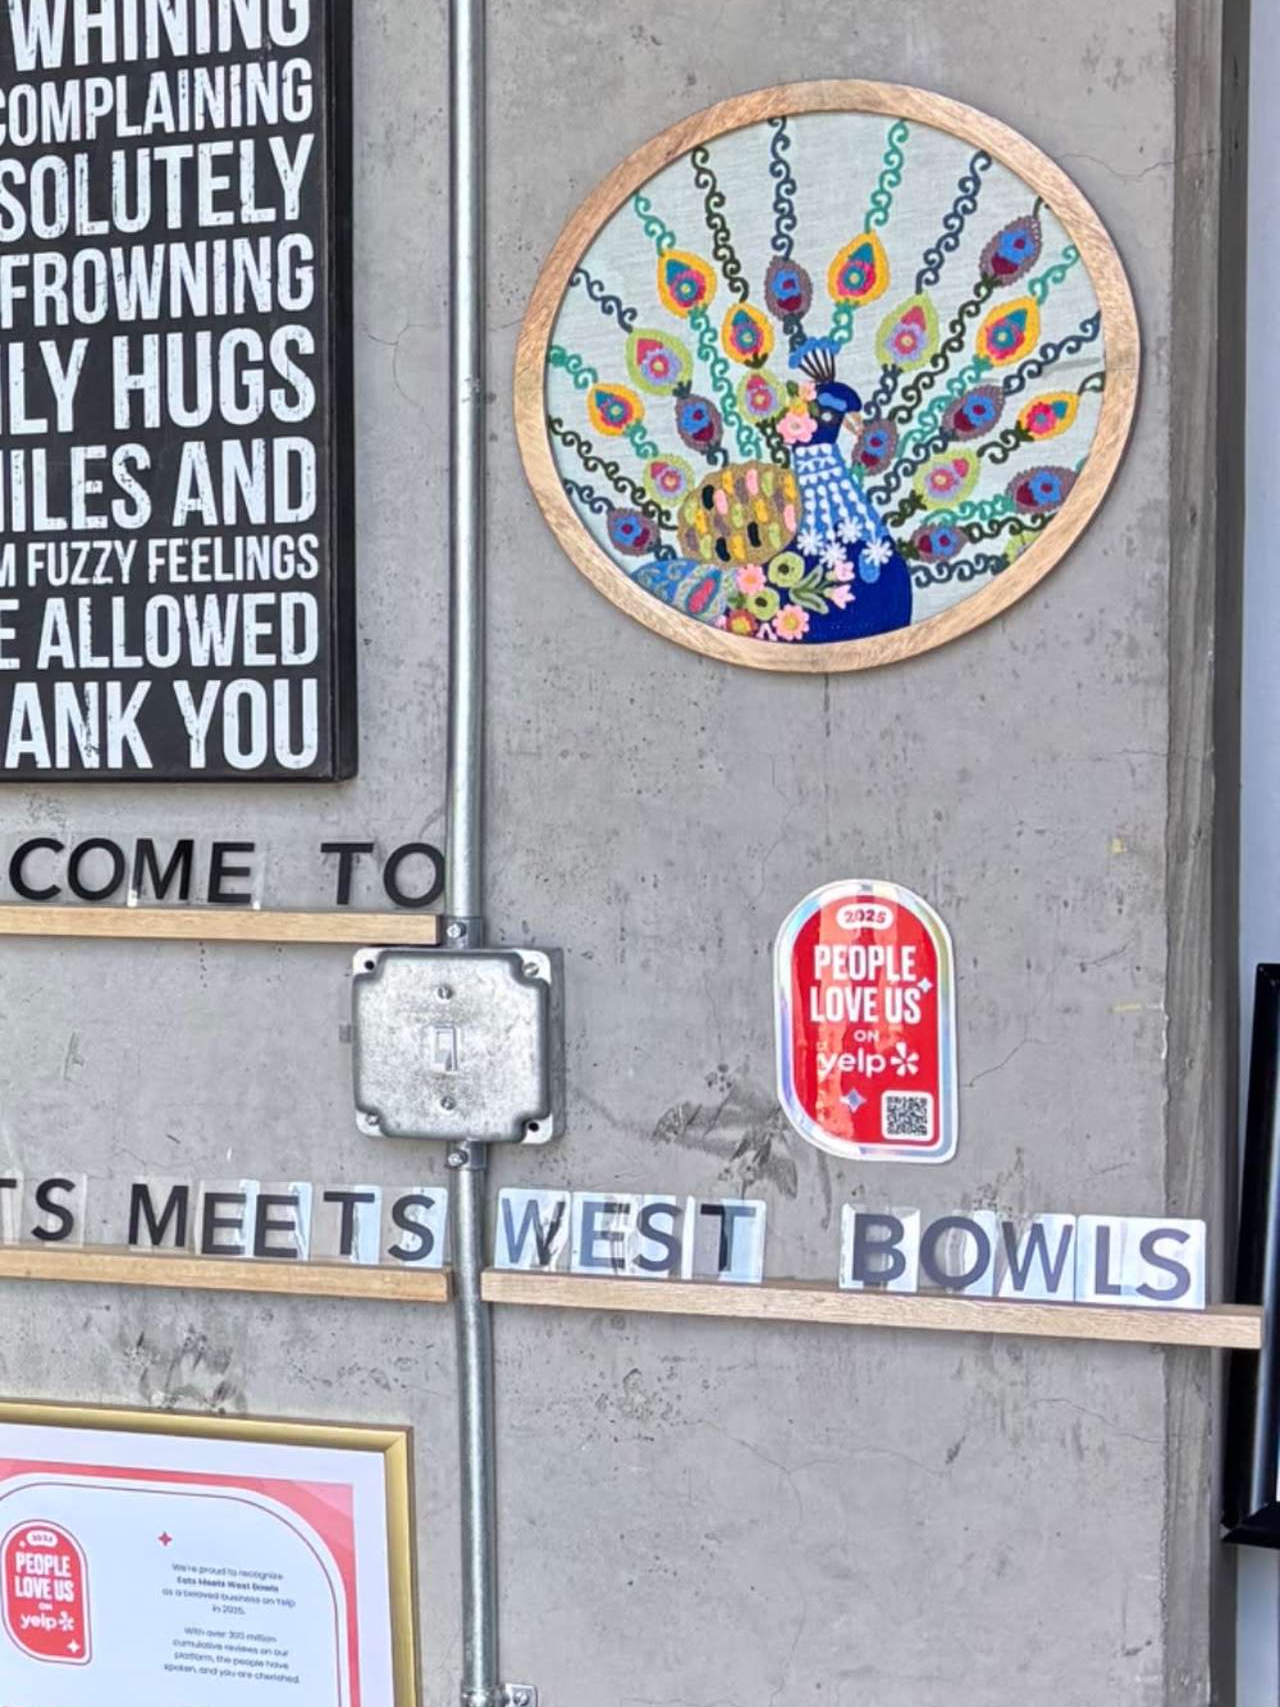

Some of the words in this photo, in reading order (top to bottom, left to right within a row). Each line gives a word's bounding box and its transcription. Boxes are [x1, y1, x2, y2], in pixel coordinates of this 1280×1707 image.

[0, 233, 315, 329] FROWNING
[113, 324, 316, 430] HUGS
[172, 436, 317, 527] AND
[27, 539, 137, 587] FUZZY
[148, 533, 318, 584] FEELINGS
[37, 591, 318, 669] ALLOWED
[173, 677, 318, 770] YOU
[320, 842, 446, 908] TO
[843, 907, 888, 924] 2025
[813, 944, 917, 983] PEOPLE
[810, 986, 879, 1024] LOVE
[884, 987, 922, 1024] US
[853, 1028, 880, 1043] ON
[816, 1047, 886, 1078] yelp
[128, 1182, 437, 1263] MEETS
[501, 1197, 757, 1272] WEST
[851, 1212, 1192, 1301] BOWLS
[15, 1551, 73, 1578] PEOPLE
[14, 1575, 53, 1600] LOVE
[53, 1580, 75, 1602] US
[20, 1612, 57, 1631] yelp
